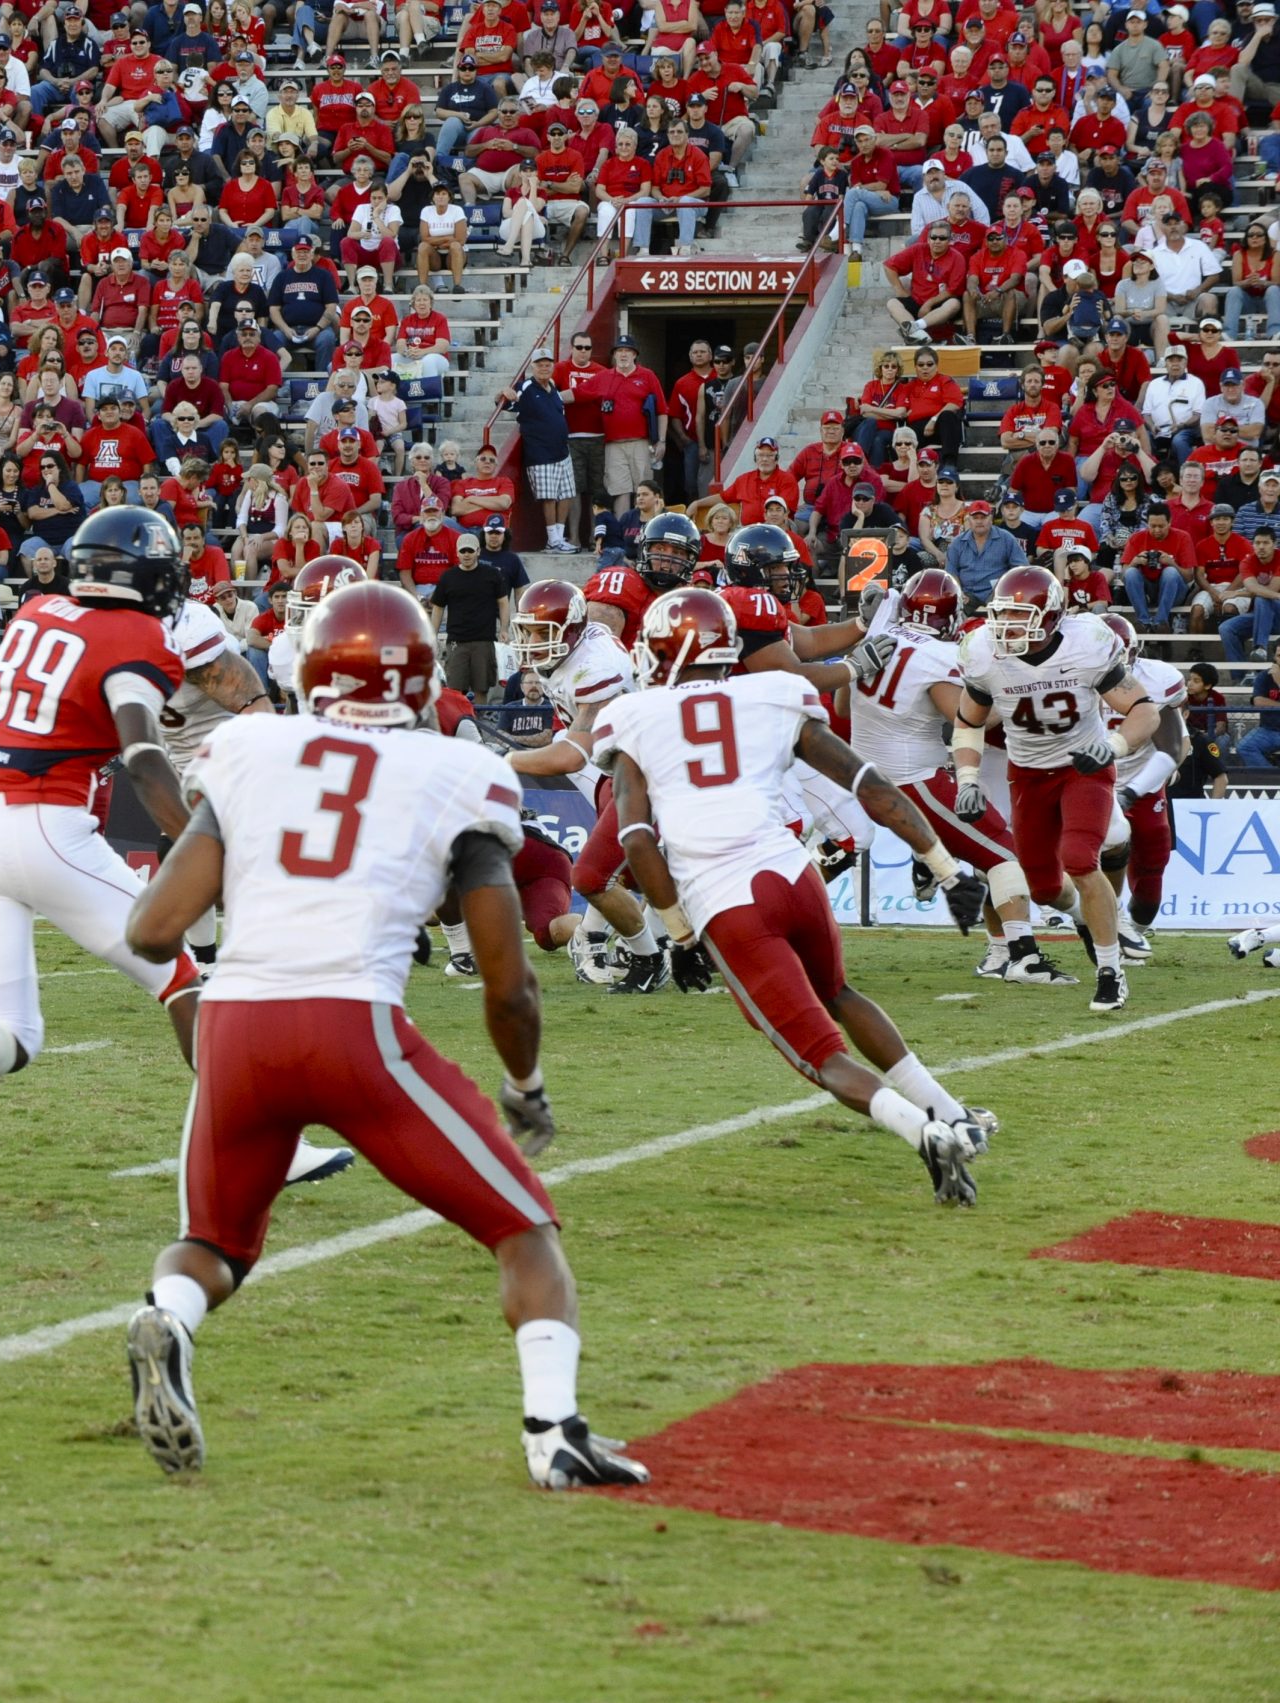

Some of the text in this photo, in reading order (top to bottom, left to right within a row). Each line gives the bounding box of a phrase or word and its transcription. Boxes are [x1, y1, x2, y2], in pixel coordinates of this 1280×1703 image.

[184, 74, 195, 88] 5
[990, 95, 1004, 114] 7
[284, 282, 319, 294] ARIZONA
[660, 271, 778, 290] 23 SECTION 24
[95, 440, 122, 463] A
[145, 521, 173, 559] A
[732, 543, 751, 566] A
[847, 537, 888, 591] 2
[598, 571, 624, 595] 78
[750, 593, 777, 617] 70
[913, 611, 928, 625] 61
[383, 669, 400, 701] 3
[1002, 678, 1079, 696] WASHINGTON STATE
[512, 716, 543, 732] ARIZONA
[1011, 690, 1080, 735] 43
[680, 693, 740, 788] 9
[279, 736, 379, 879] 3
[1191, 897, 1211, 916] it
